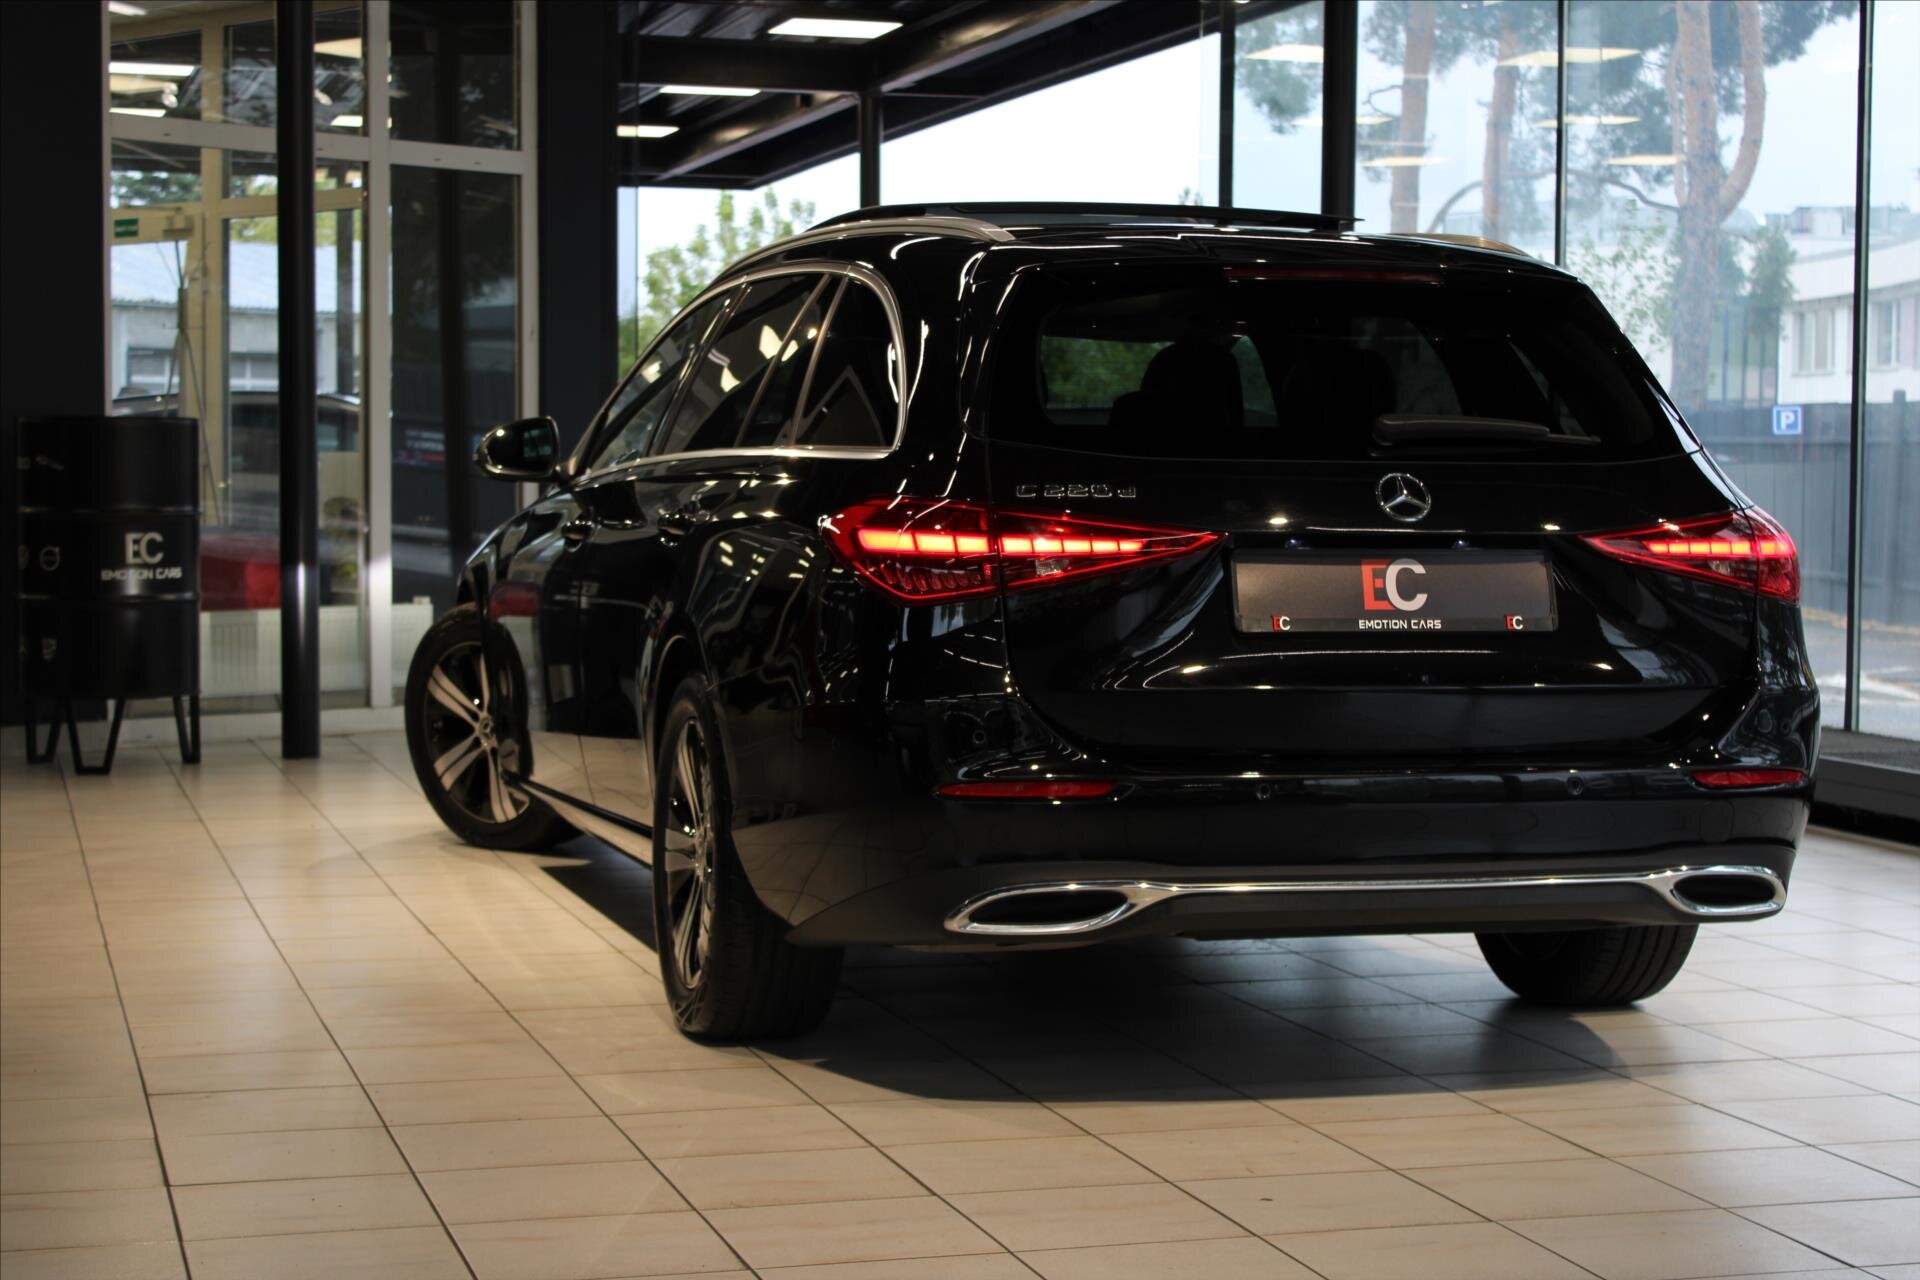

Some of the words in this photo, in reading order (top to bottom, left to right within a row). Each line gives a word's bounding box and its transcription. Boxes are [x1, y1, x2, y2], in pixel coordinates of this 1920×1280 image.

[1780, 411, 1795, 431] P
[1016, 484, 1037, 498] C
[1044, 484, 1113, 498] 220
[125, 532, 164, 565] EC
[1360, 558, 1428, 611] EC
[1272, 615, 1291, 630] EC
[1358, 619, 1407, 630] EMOTION
[1410, 619, 1442, 630] CARS
[1505, 615, 1524, 630] EC
